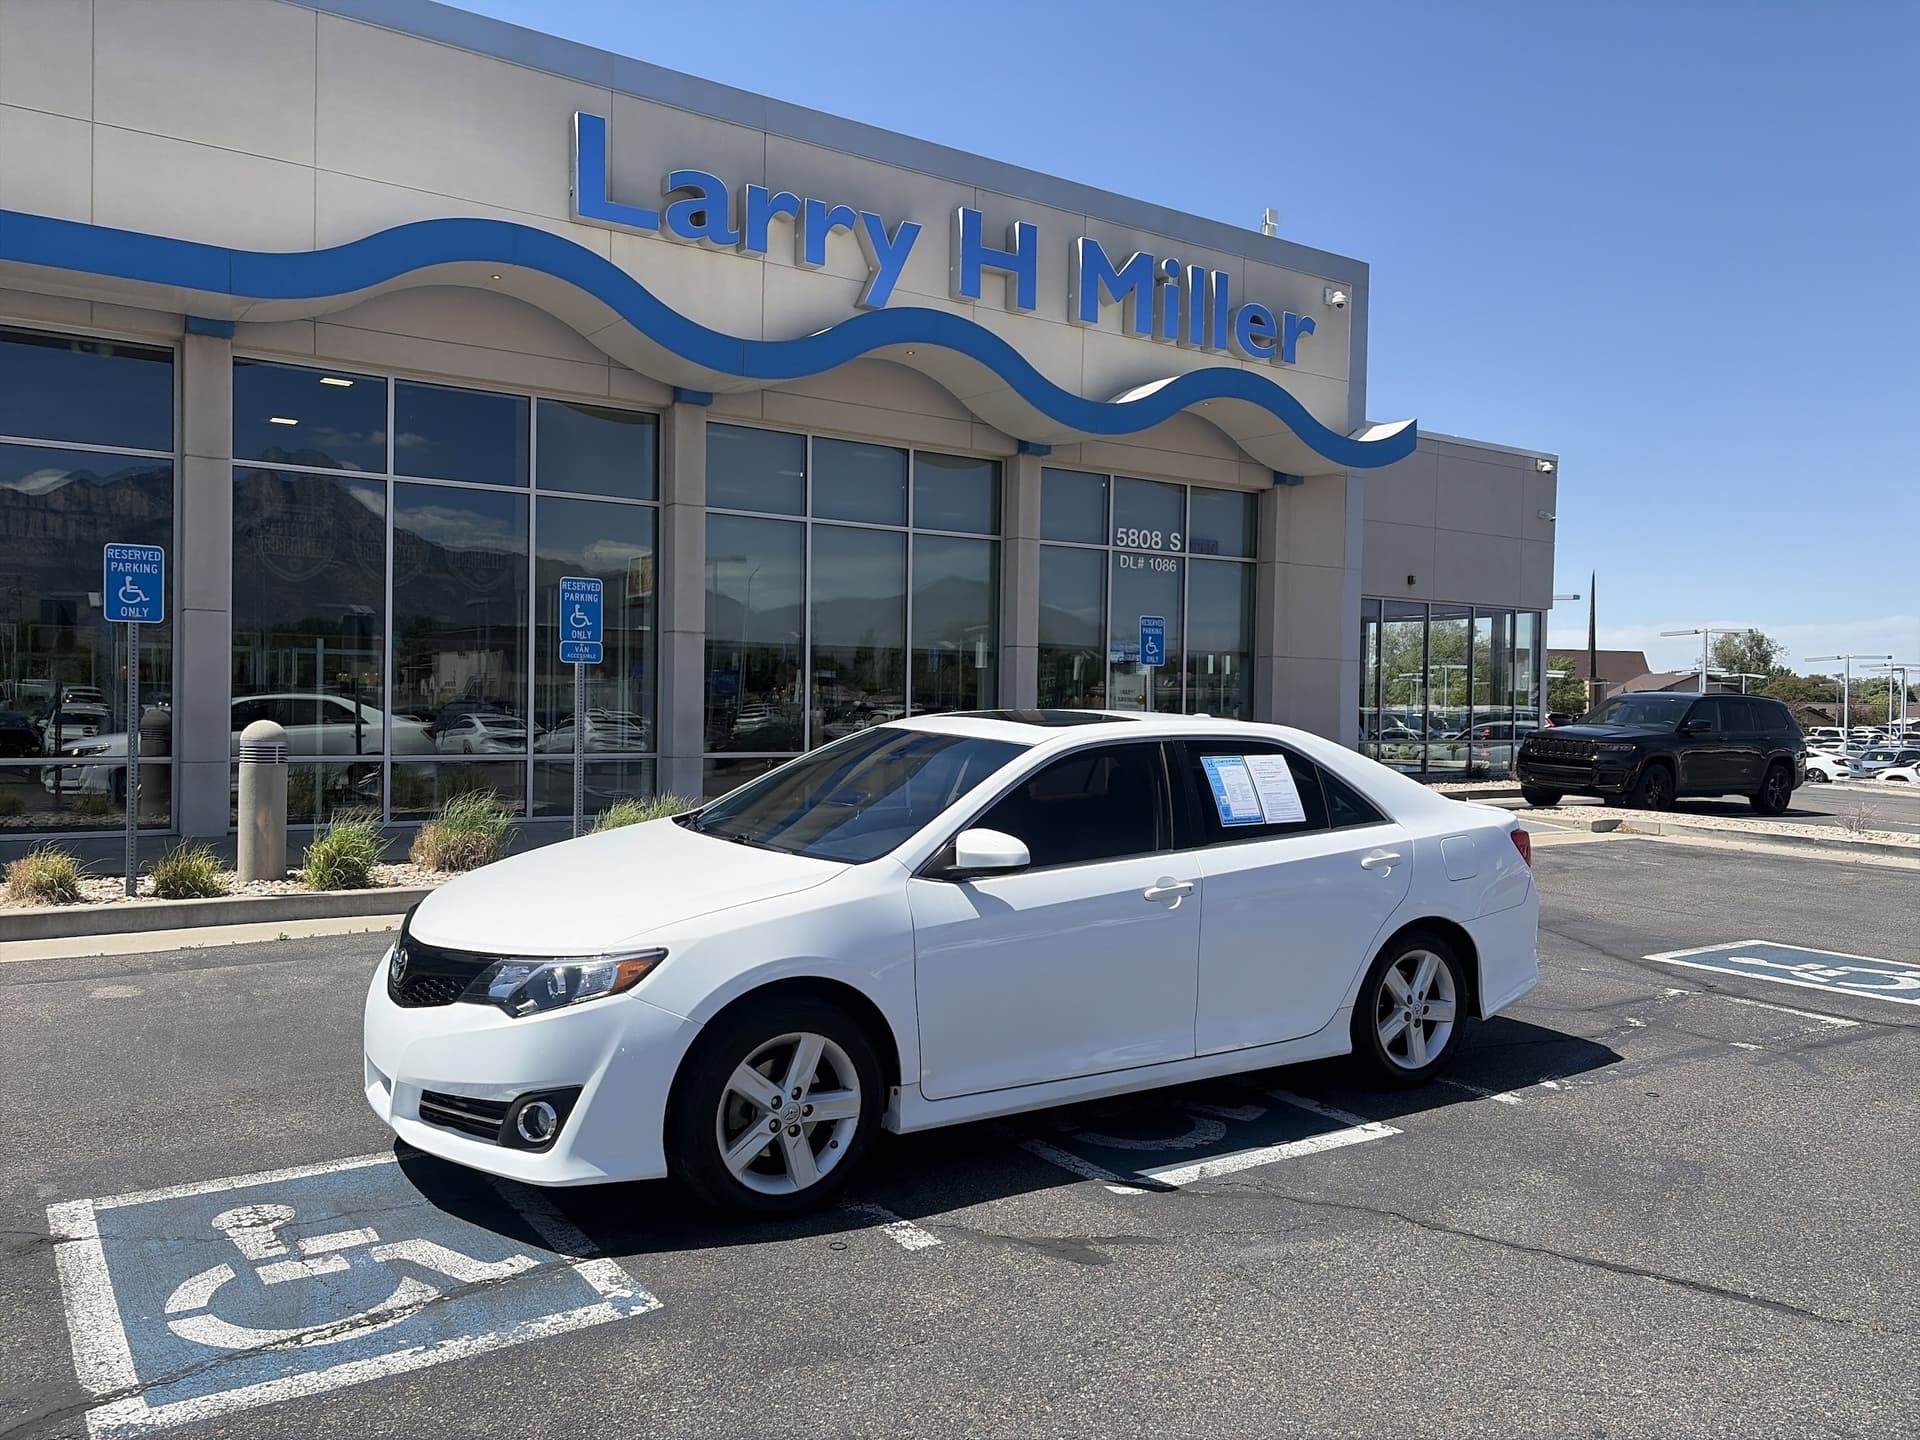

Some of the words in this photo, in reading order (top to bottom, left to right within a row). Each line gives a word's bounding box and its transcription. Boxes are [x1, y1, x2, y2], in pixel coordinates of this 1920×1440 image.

[572, 111, 922, 309] Larry
[952, 206, 1038, 312] H
[1071, 236, 1317, 366] Miller
[1116, 528, 1162, 549] 5808
[1169, 532, 1181, 551] S
[107, 548, 161, 561] RESERVED
[111, 561, 158, 574] PARKING
[1120, 554, 1144, 569] DL#
[1149, 558, 1177, 572] 1086
[562, 581, 600, 592] RESERVED
[564, 592, 598, 603] PARKING
[120, 606, 149, 617] ONLY
[572, 630, 592, 639] ONLY
[574, 645, 590, 653] VAN
